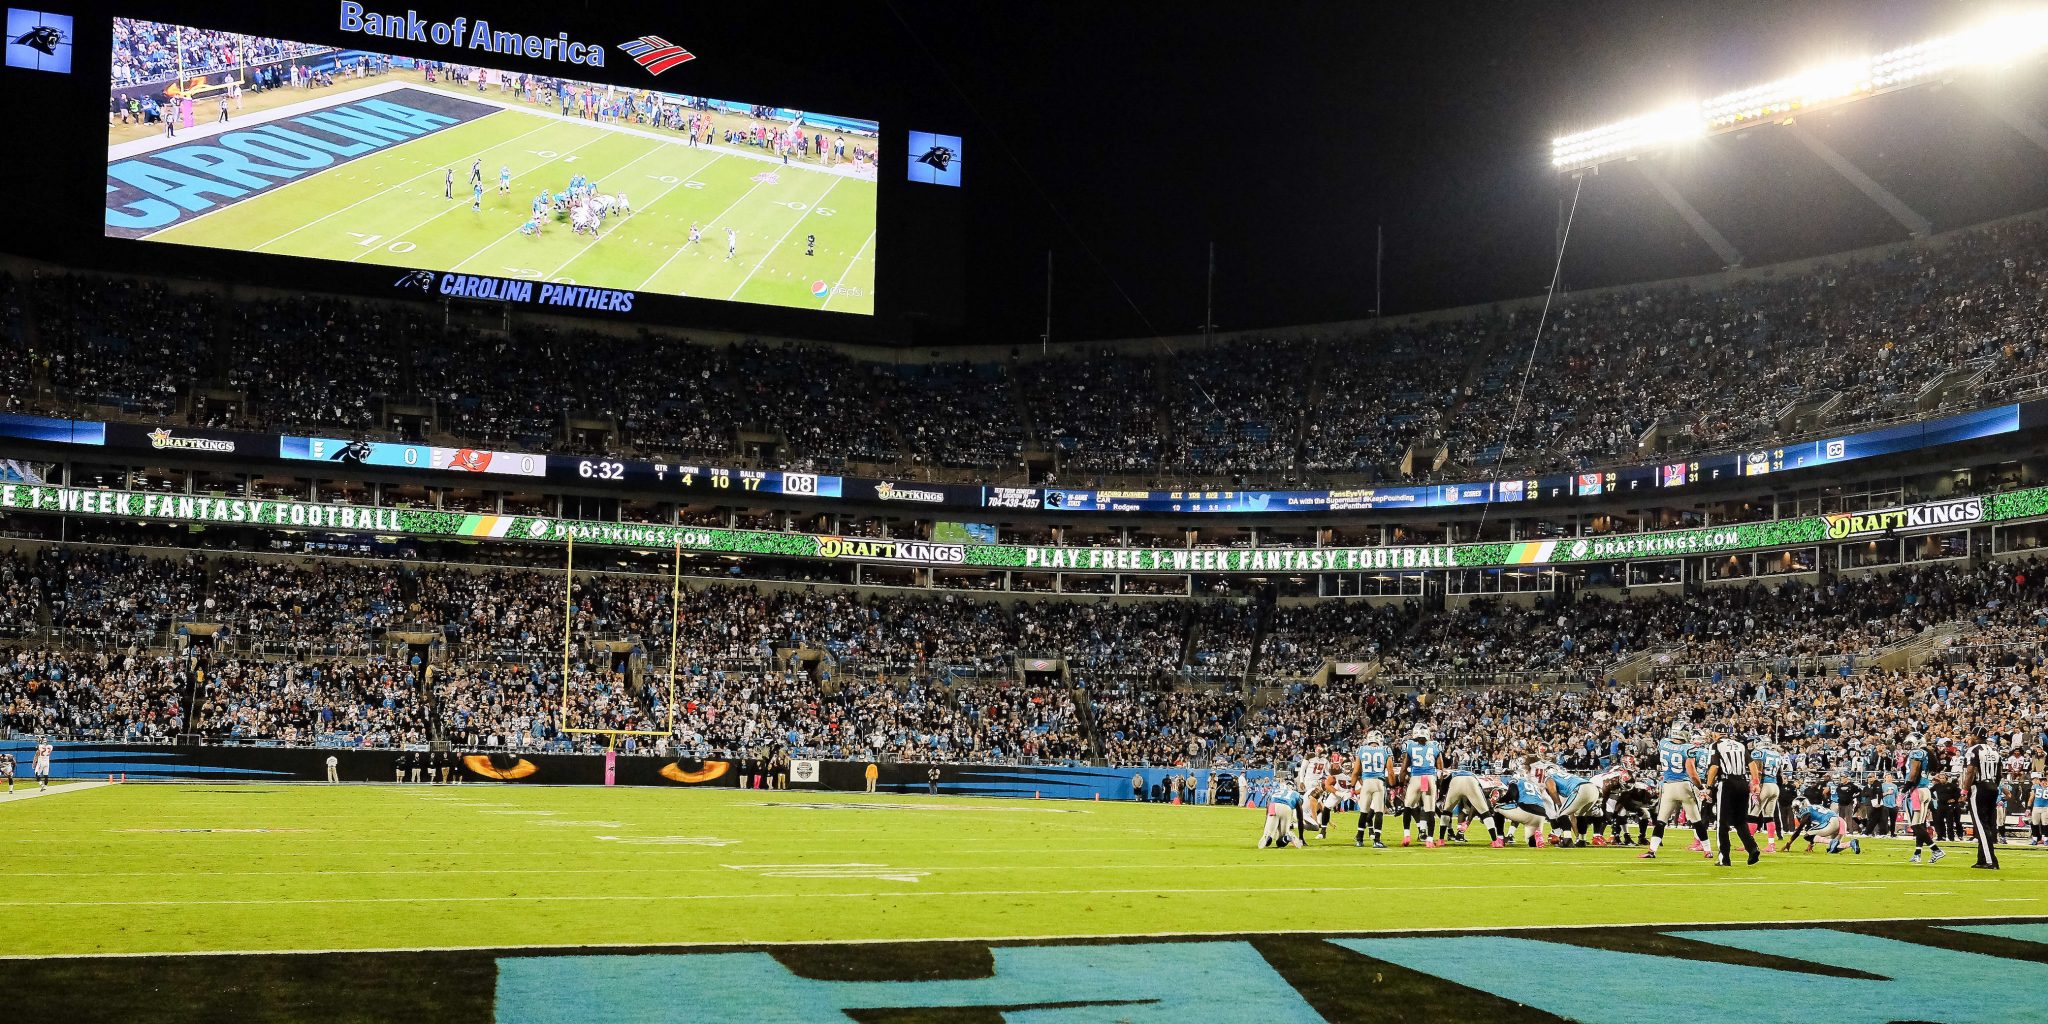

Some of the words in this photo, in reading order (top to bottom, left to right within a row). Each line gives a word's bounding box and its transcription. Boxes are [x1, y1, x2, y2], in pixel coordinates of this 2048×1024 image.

[340, 0, 427, 42] Bank
[431, 17, 467, 47] of
[468, 20, 605, 67] America
[105, 99, 460, 228] CAROLINA
[440, 274, 532, 302] CAROLINA
[539, 284, 634, 312] PANTHERS
[152, 437, 235, 452] DRAFTKINGS
[1829, 443, 1843, 457] CC
[404, 448, 417, 464] 0
[1797, 457, 1804, 466] F
[521, 456, 534, 473] 0
[579, 460, 624, 480] 6:32
[654, 464, 668, 472] QTR
[680, 466, 699, 474] DOWN
[1689, 462, 1699, 471] 13
[1773, 460, 1783, 470] 31
[658, 472, 663, 480] 1
[710, 468, 719, 476] TO
[740, 470, 755, 478] BALL
[1606, 473, 1616, 482] 30
[1688, 472, 1699, 482] 31
[1712, 470, 1719, 479] F
[681, 473, 692, 486] 4
[711, 476, 729, 489] 10
[742, 478, 760, 491] 17
[788, 477, 812, 493] 08
[1527, 480, 1538, 490] 23
[1631, 480, 1638, 490] F
[1553, 488, 1559, 498] F
[1606, 482, 1616, 492] 17
[879, 489, 944, 502] DRAFTKINGS
[1300, 497, 1314, 505] with
[1527, 491, 1539, 499] 29
[988, 497, 1040, 508] 704-438-4357
[1113, 504, 1140, 512] Rodgers
[30, 487, 132, 515] 1-WEEK
[145, 495, 264, 522] FANTASY
[275, 504, 401, 532] FOOTBALL
[1829, 502, 1980, 538] DRAFTKINGS
[555, 524, 710, 545] DRAFTKINGS.COM
[1593, 531, 1738, 555] DRAFTKINGS.COM
[820, 539, 964, 562] DRAFTKINGS
[1026, 548, 1080, 568] PLAY
[1090, 549, 1141, 569] FREE
[1151, 550, 1229, 570] 1-WEEK
[1239, 549, 1337, 570] FANTASY
[1348, 546, 1457, 569] FOOTBALL
[1361, 752, 1385, 773] 20
[1411, 746, 1435, 767] 54
[1660, 750, 1683, 774] 59
[2035, 788, 2048, 800] 56
